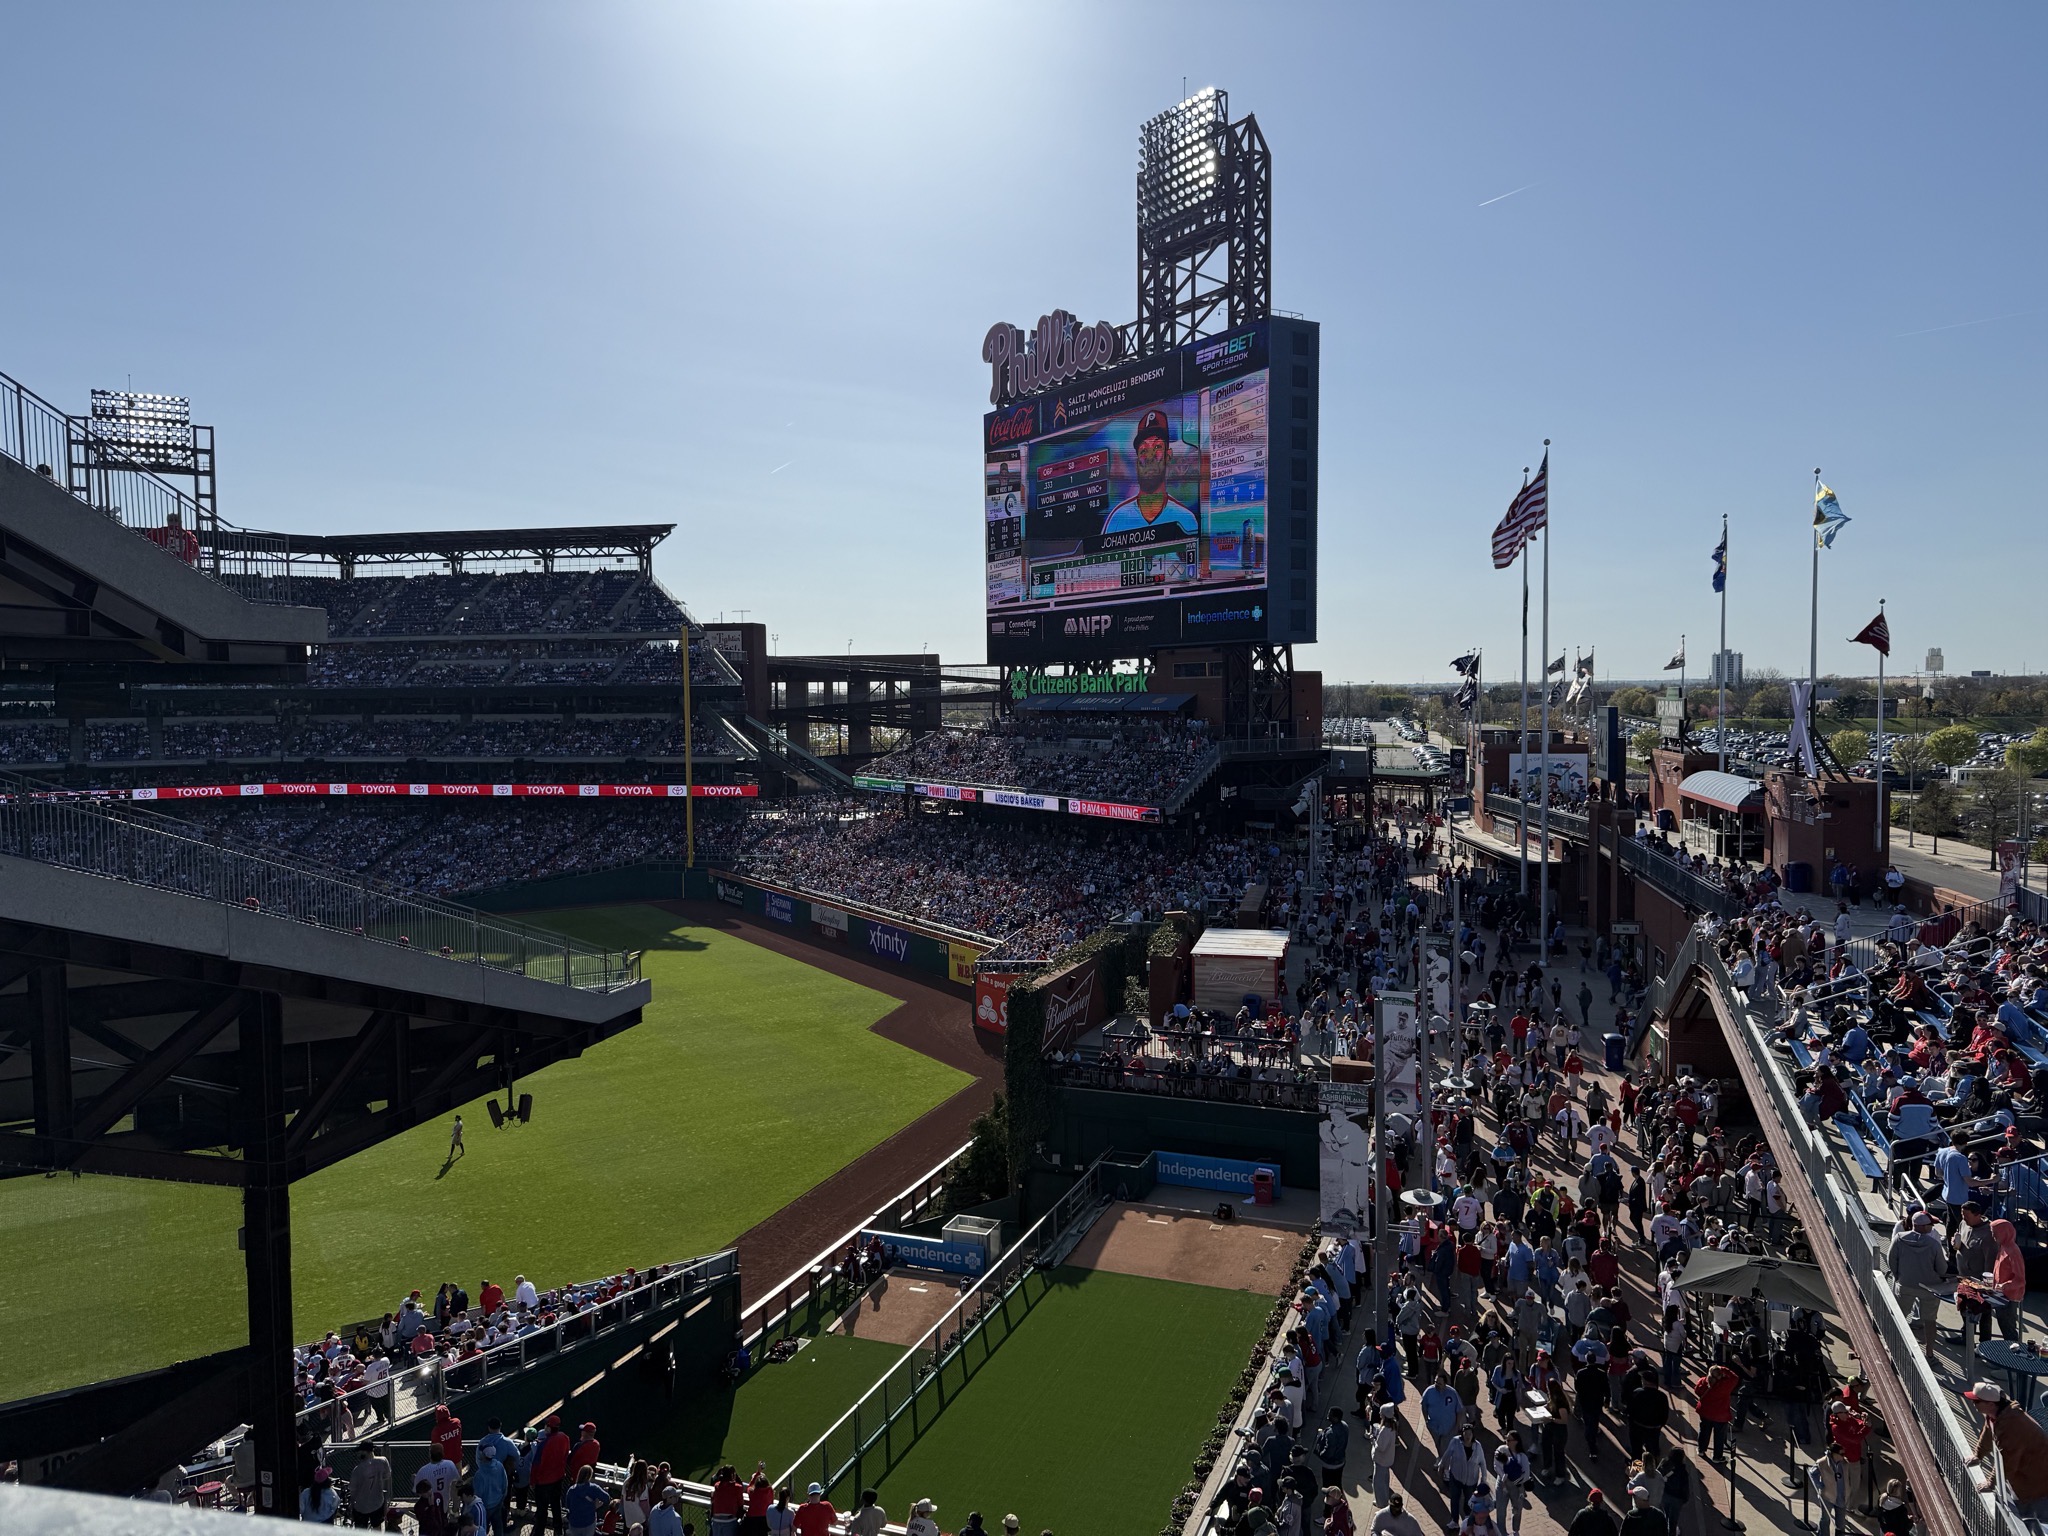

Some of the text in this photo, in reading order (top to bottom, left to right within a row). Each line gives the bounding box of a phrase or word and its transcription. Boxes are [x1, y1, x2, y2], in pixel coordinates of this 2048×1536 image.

[1195, 331, 1256, 366] ESPN BET
[982, 308, 1115, 405] Phillies
[1202, 351, 1249, 373] SPORTSBOOK
[1068, 366, 1166, 407] SALTZ MONGELUZZI BENDESKY
[1068, 392, 1126, 418] INJURY LAWYERS
[1218, 399, 1234, 411] STOTT
[1218, 408, 1237, 421] TURNER
[1218, 418, 1238, 431] HARPER
[1217, 423, 1250, 440] SCHWARBER
[1217, 432, 1255, 448] CASTELLANOS
[1217, 447, 1236, 459] KEPLER
[1068, 461, 1075, 470] SB
[1088, 455, 1100, 464] OPS
[1217, 456, 1245, 469] REALMUTO
[1217, 467, 1233, 478] BOHM
[1043, 481, 1053, 490] .333
[1217, 478, 1235, 487] ROJAS
[1040, 485, 1102, 505] WOBA XWOBA WRC+
[1043, 509, 1053, 518] .312
[1101, 529, 1156, 550] JOHAN ROJAS
[1188, 552, 1194, 561] 3
[1044, 574, 1051, 582] SF
[1130, 560, 1135, 570] 2
[1122, 574, 1127, 586] 5
[1130, 573, 1135, 584] 5
[1128, 616, 1140, 624] proud
[1187, 609, 1250, 624] Independence
[1008, 619, 1037, 630] Connecting
[1078, 614, 1112, 638] NFP
[1029, 669, 1148, 694] Citizens Bank Park
[175, 787, 223, 797] TOYOTA
[281, 785, 317, 794] TOYOTA
[360, 785, 397, 794] TOYOTA
[441, 785, 480, 794] TOYOTA
[526, 785, 566, 795] TOYOTA
[613, 786, 653, 795] TOYOTA
[702, 786, 743, 796] TOYOTA
[928, 786, 945, 797] POWER
[946, 788, 960, 799] ALLEY
[961, 790, 976, 800] NECA
[995, 793, 1045, 808] LISCIO'S BAKERY
[1081, 802, 1139, 819] RAV4th INNING
[771, 895, 791, 911] SHERWIN
[821, 925, 838, 938] LAGER
[869, 926, 908, 962] xfinity
[938, 942, 948, 955] 374
[980, 974, 990, 984] Like
[994, 980, 1006, 989] good
[1211, 970, 1259, 984] Budweiser
[1046, 992, 1091, 1034] Budweiser
[1322, 1092, 1352, 1102] ASHBURN
[1157, 1159, 1256, 1186] Independence
[1464, 1205, 1470, 1216] 7
[1660, 1224, 1671, 1235] 12
[377, 1368, 388, 1381] 45
[440, 1428, 461, 1443] STAFF
[432, 1467, 447, 1477] STOTT
[368, 1476, 376, 1490] 7
[436, 1478, 445, 1491] 5
